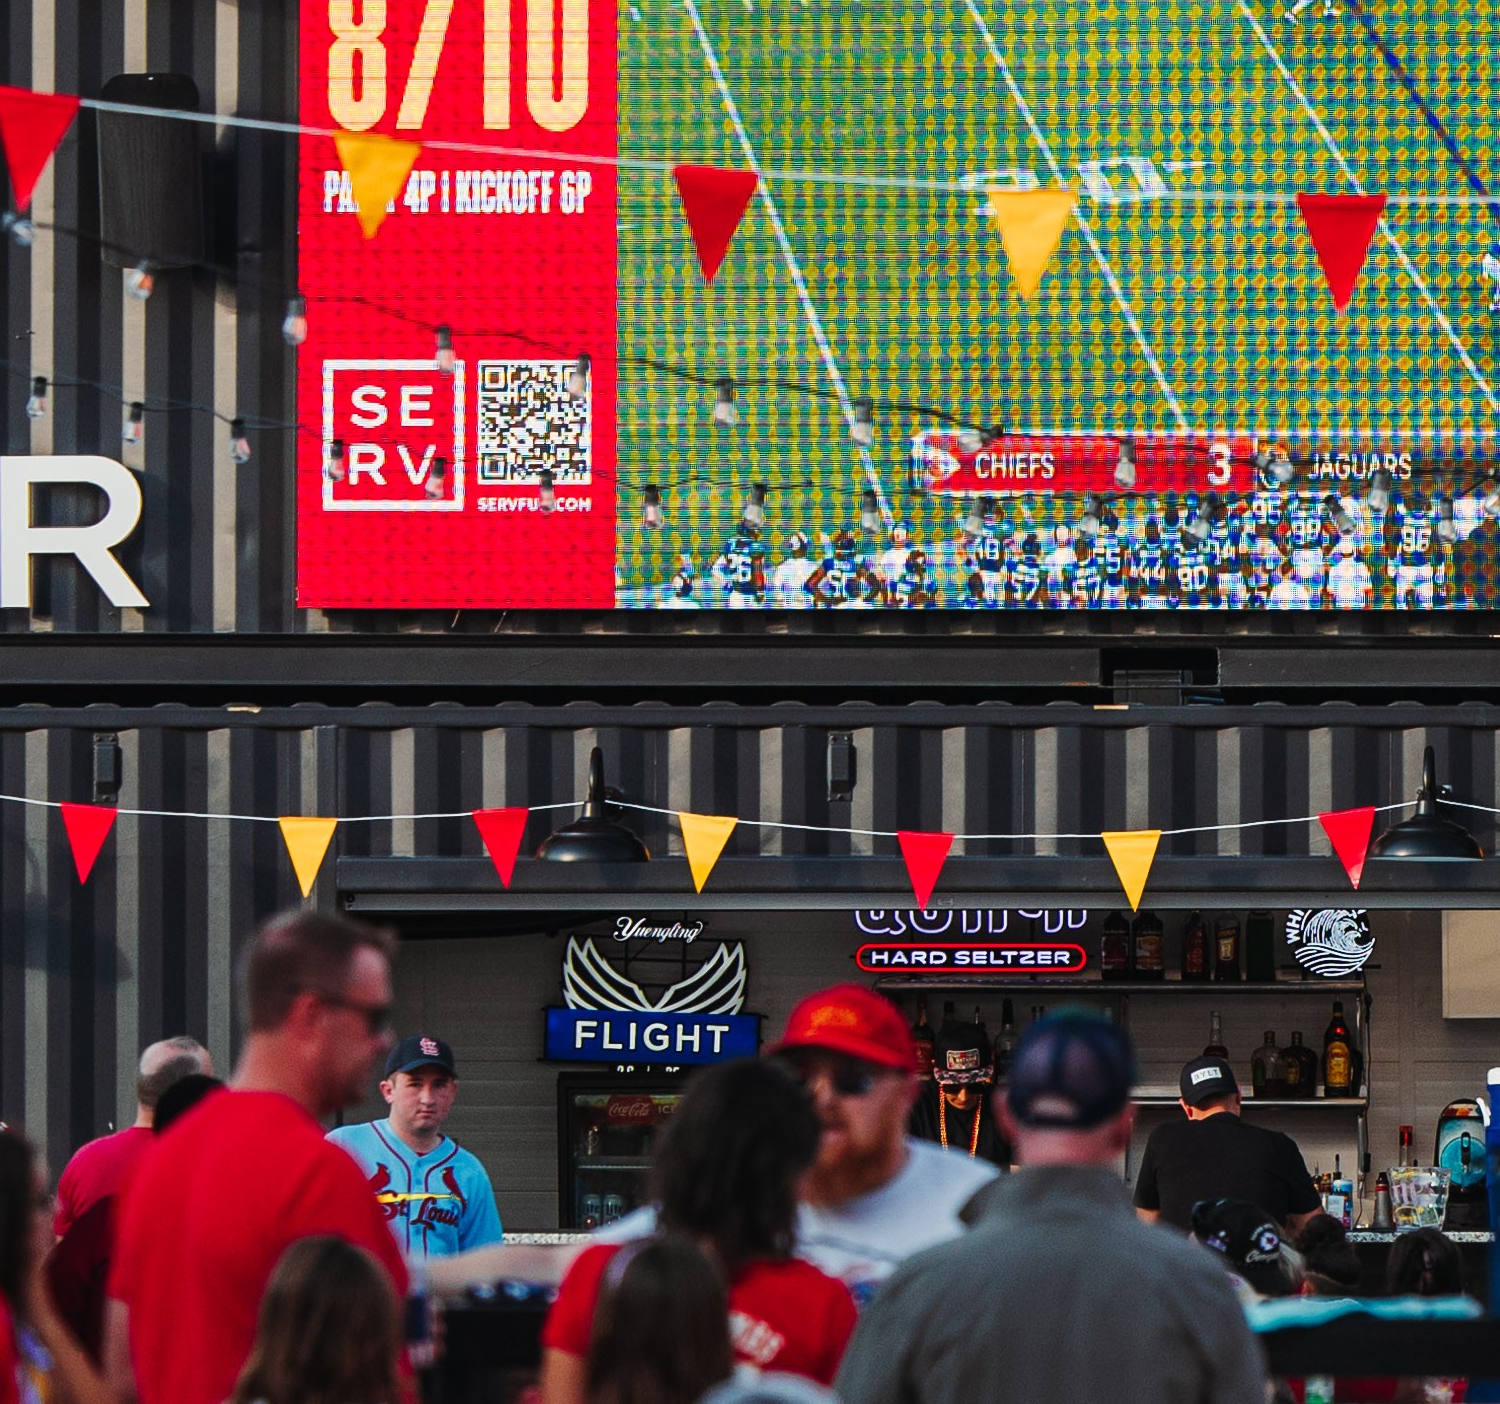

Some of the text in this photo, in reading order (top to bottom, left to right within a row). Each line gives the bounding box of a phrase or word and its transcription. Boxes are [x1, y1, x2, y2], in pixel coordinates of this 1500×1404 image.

[403, 170, 437, 213] 4P
[455, 170, 555, 213] KICKOFF
[559, 170, 592, 214] 6P
[349, 385, 435, 428] SE
[348, 443, 437, 486] RV
[974, 452, 1055, 480] CHIEFS
[1207, 443, 1231, 485] 3
[1307, 452, 1412, 480] JAGUARS
[477, 498, 592, 512] SERVFUCOM
[613, 916, 704, 944] Yuengling
[871, 950, 1071, 966] HARD SELTZER
[574, 1020, 730, 1053] FLIGHT
[608, 1102, 650, 1117] Coca-Cola
